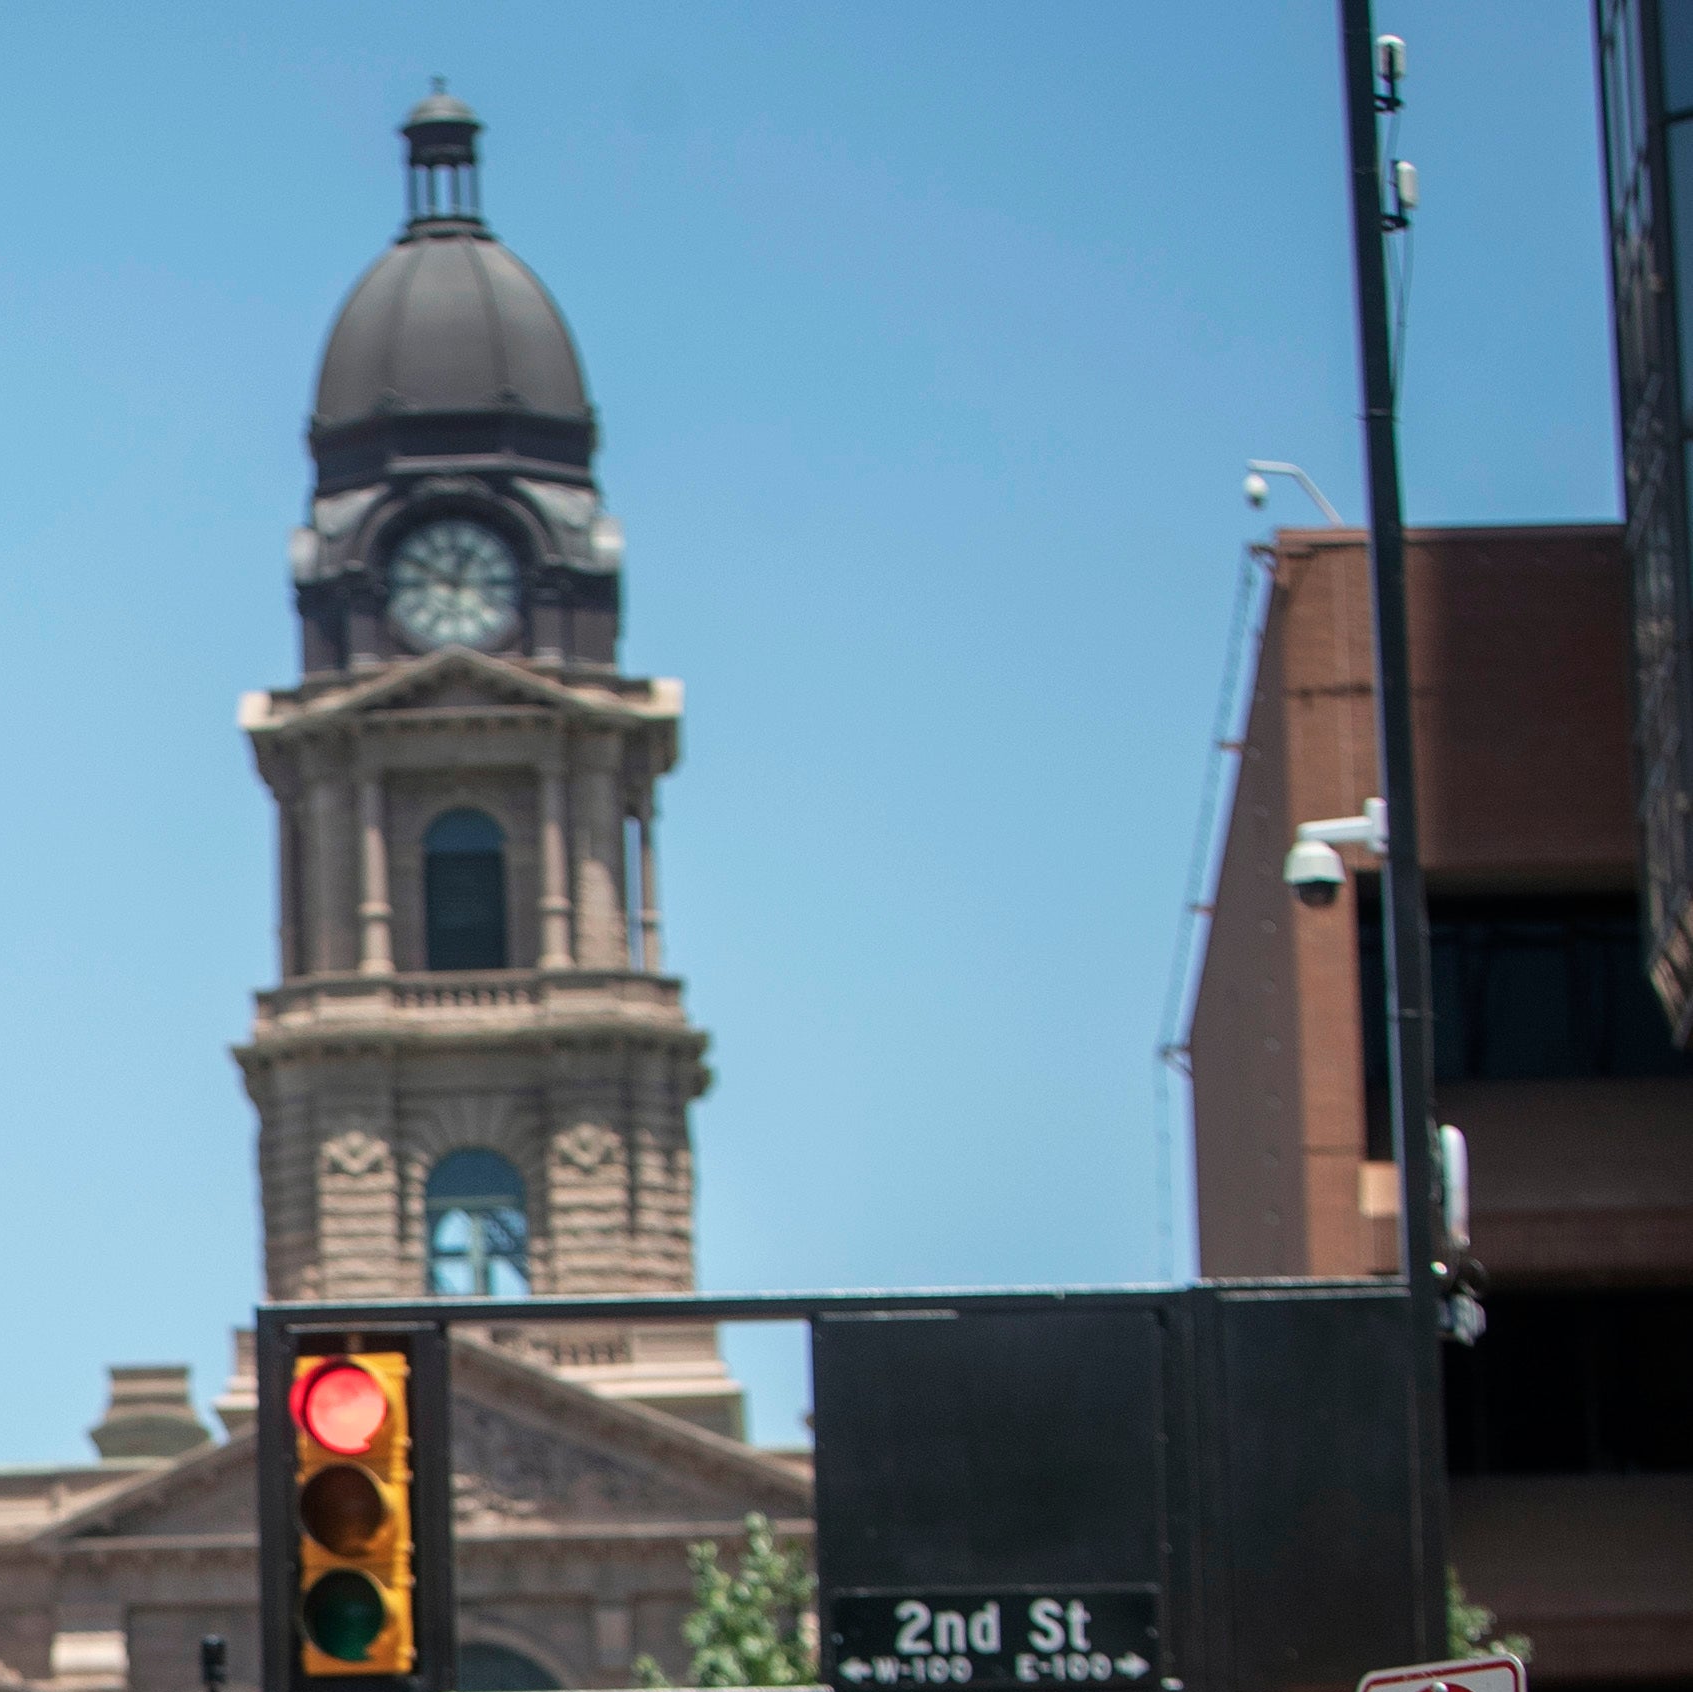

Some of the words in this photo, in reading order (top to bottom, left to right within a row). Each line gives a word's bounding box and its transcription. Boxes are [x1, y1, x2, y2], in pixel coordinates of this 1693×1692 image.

[894, 1599, 1001, 1654] 2nd
[1028, 1598, 1092, 1652] St
[871, 1655, 972, 1684] W-100
[1015, 1652, 1112, 1682] E-100
